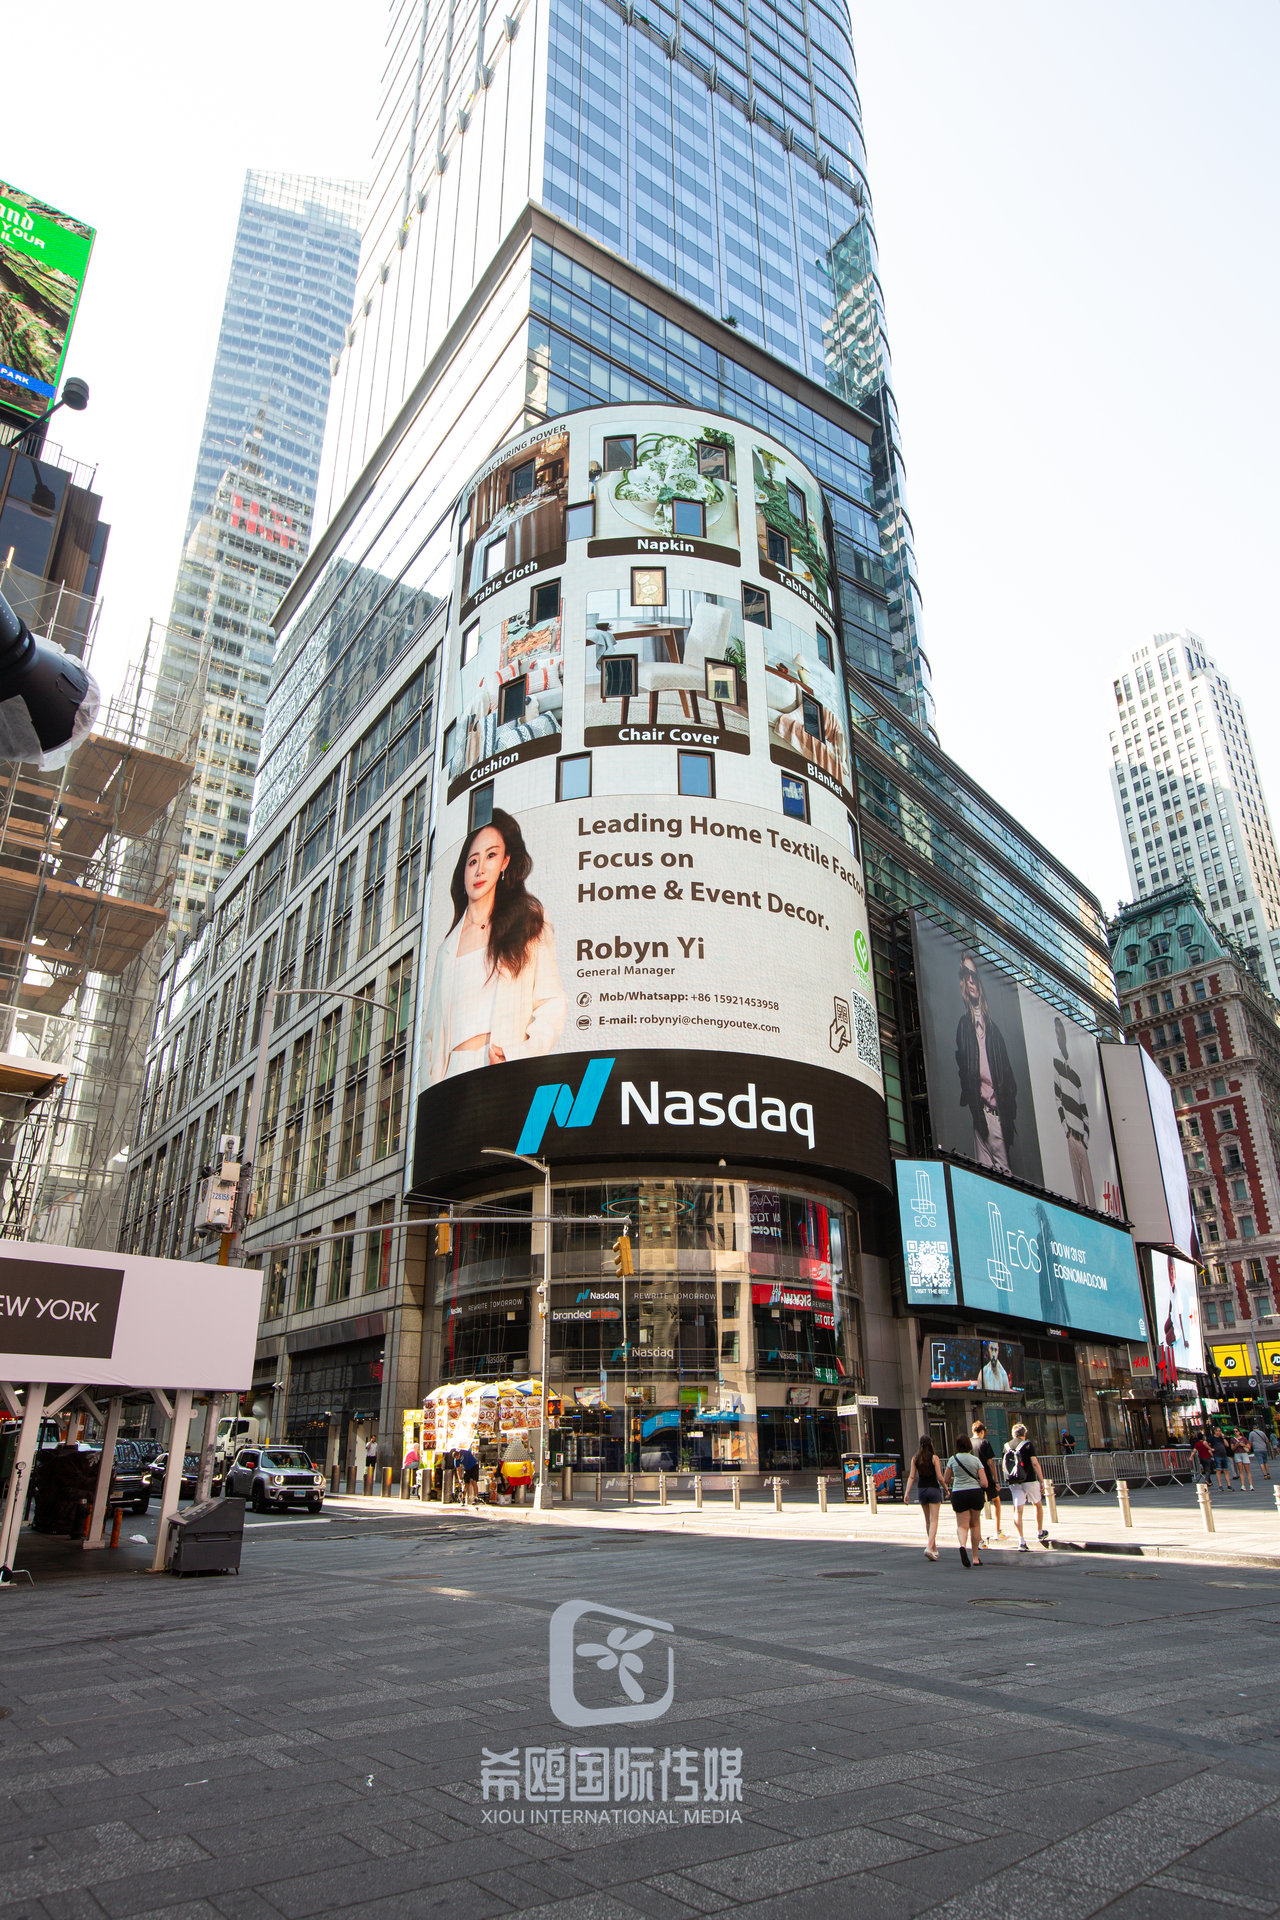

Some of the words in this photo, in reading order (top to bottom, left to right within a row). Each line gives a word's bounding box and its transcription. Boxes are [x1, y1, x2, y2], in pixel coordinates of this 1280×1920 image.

[1, 220, 46, 249] YOUR
[1, 367, 29, 385] PARK
[530, 424, 567, 445] POWER
[637, 538, 695, 553] Napkin
[473, 577, 503, 605] Table
[505, 561, 539, 590] Cloth
[778, 571, 808, 599] Table
[618, 727, 665, 743] Chair
[669, 729, 720, 747] Cover
[469, 751, 520, 782] Cushion
[807, 762, 843, 797] Blanket
[577, 813, 683, 838] Leading
[690, 816, 762, 844] Home
[767, 828, 829, 870] Textile
[577, 850, 654, 871] Focus
[660, 852, 695, 869] on
[577, 881, 657, 904] Home
[664, 880, 685, 901] &
[691, 882, 762, 909] Event
[767, 892, 830, 931] Decor.
[576, 936, 669, 964] Robyn
[677, 936, 705, 960] Yi
[576, 966, 621, 978] General
[624, 966, 676, 977] Manager
[600, 991, 689, 1003] Mob/Whatsapp:
[690, 993, 712, 1002] +86
[714, 994, 780, 1011] 15921453958
[599, 1015, 638, 1025] E-mail:
[639, 1014, 781, 1034] robynyi@chengyoutex.com
[620, 1080, 816, 1150] Nasdaq
[1050, 1240, 1064, 1257] 100
[1064, 1244, 1071, 1260] W
[1071, 1246, 1079, 1263] 31
[1078, 1248, 1087, 1265] ST
[1053, 1262, 1108, 1292] EOSNOMAD.COM
[468, 1302, 488, 1312] REWRITE
[490, 1299, 523, 1309] TOMORROW
[590, 1291, 620, 1301] Nasdaq
[634, 1292, 668, 1300] REWRITE
[673, 1292, 717, 1300] TOMORROW
[34, 1297, 100, 1323] YORK
[552, 1310, 618, 1320] brandedcities
[632, 1347, 674, 1359] Nasdaq
